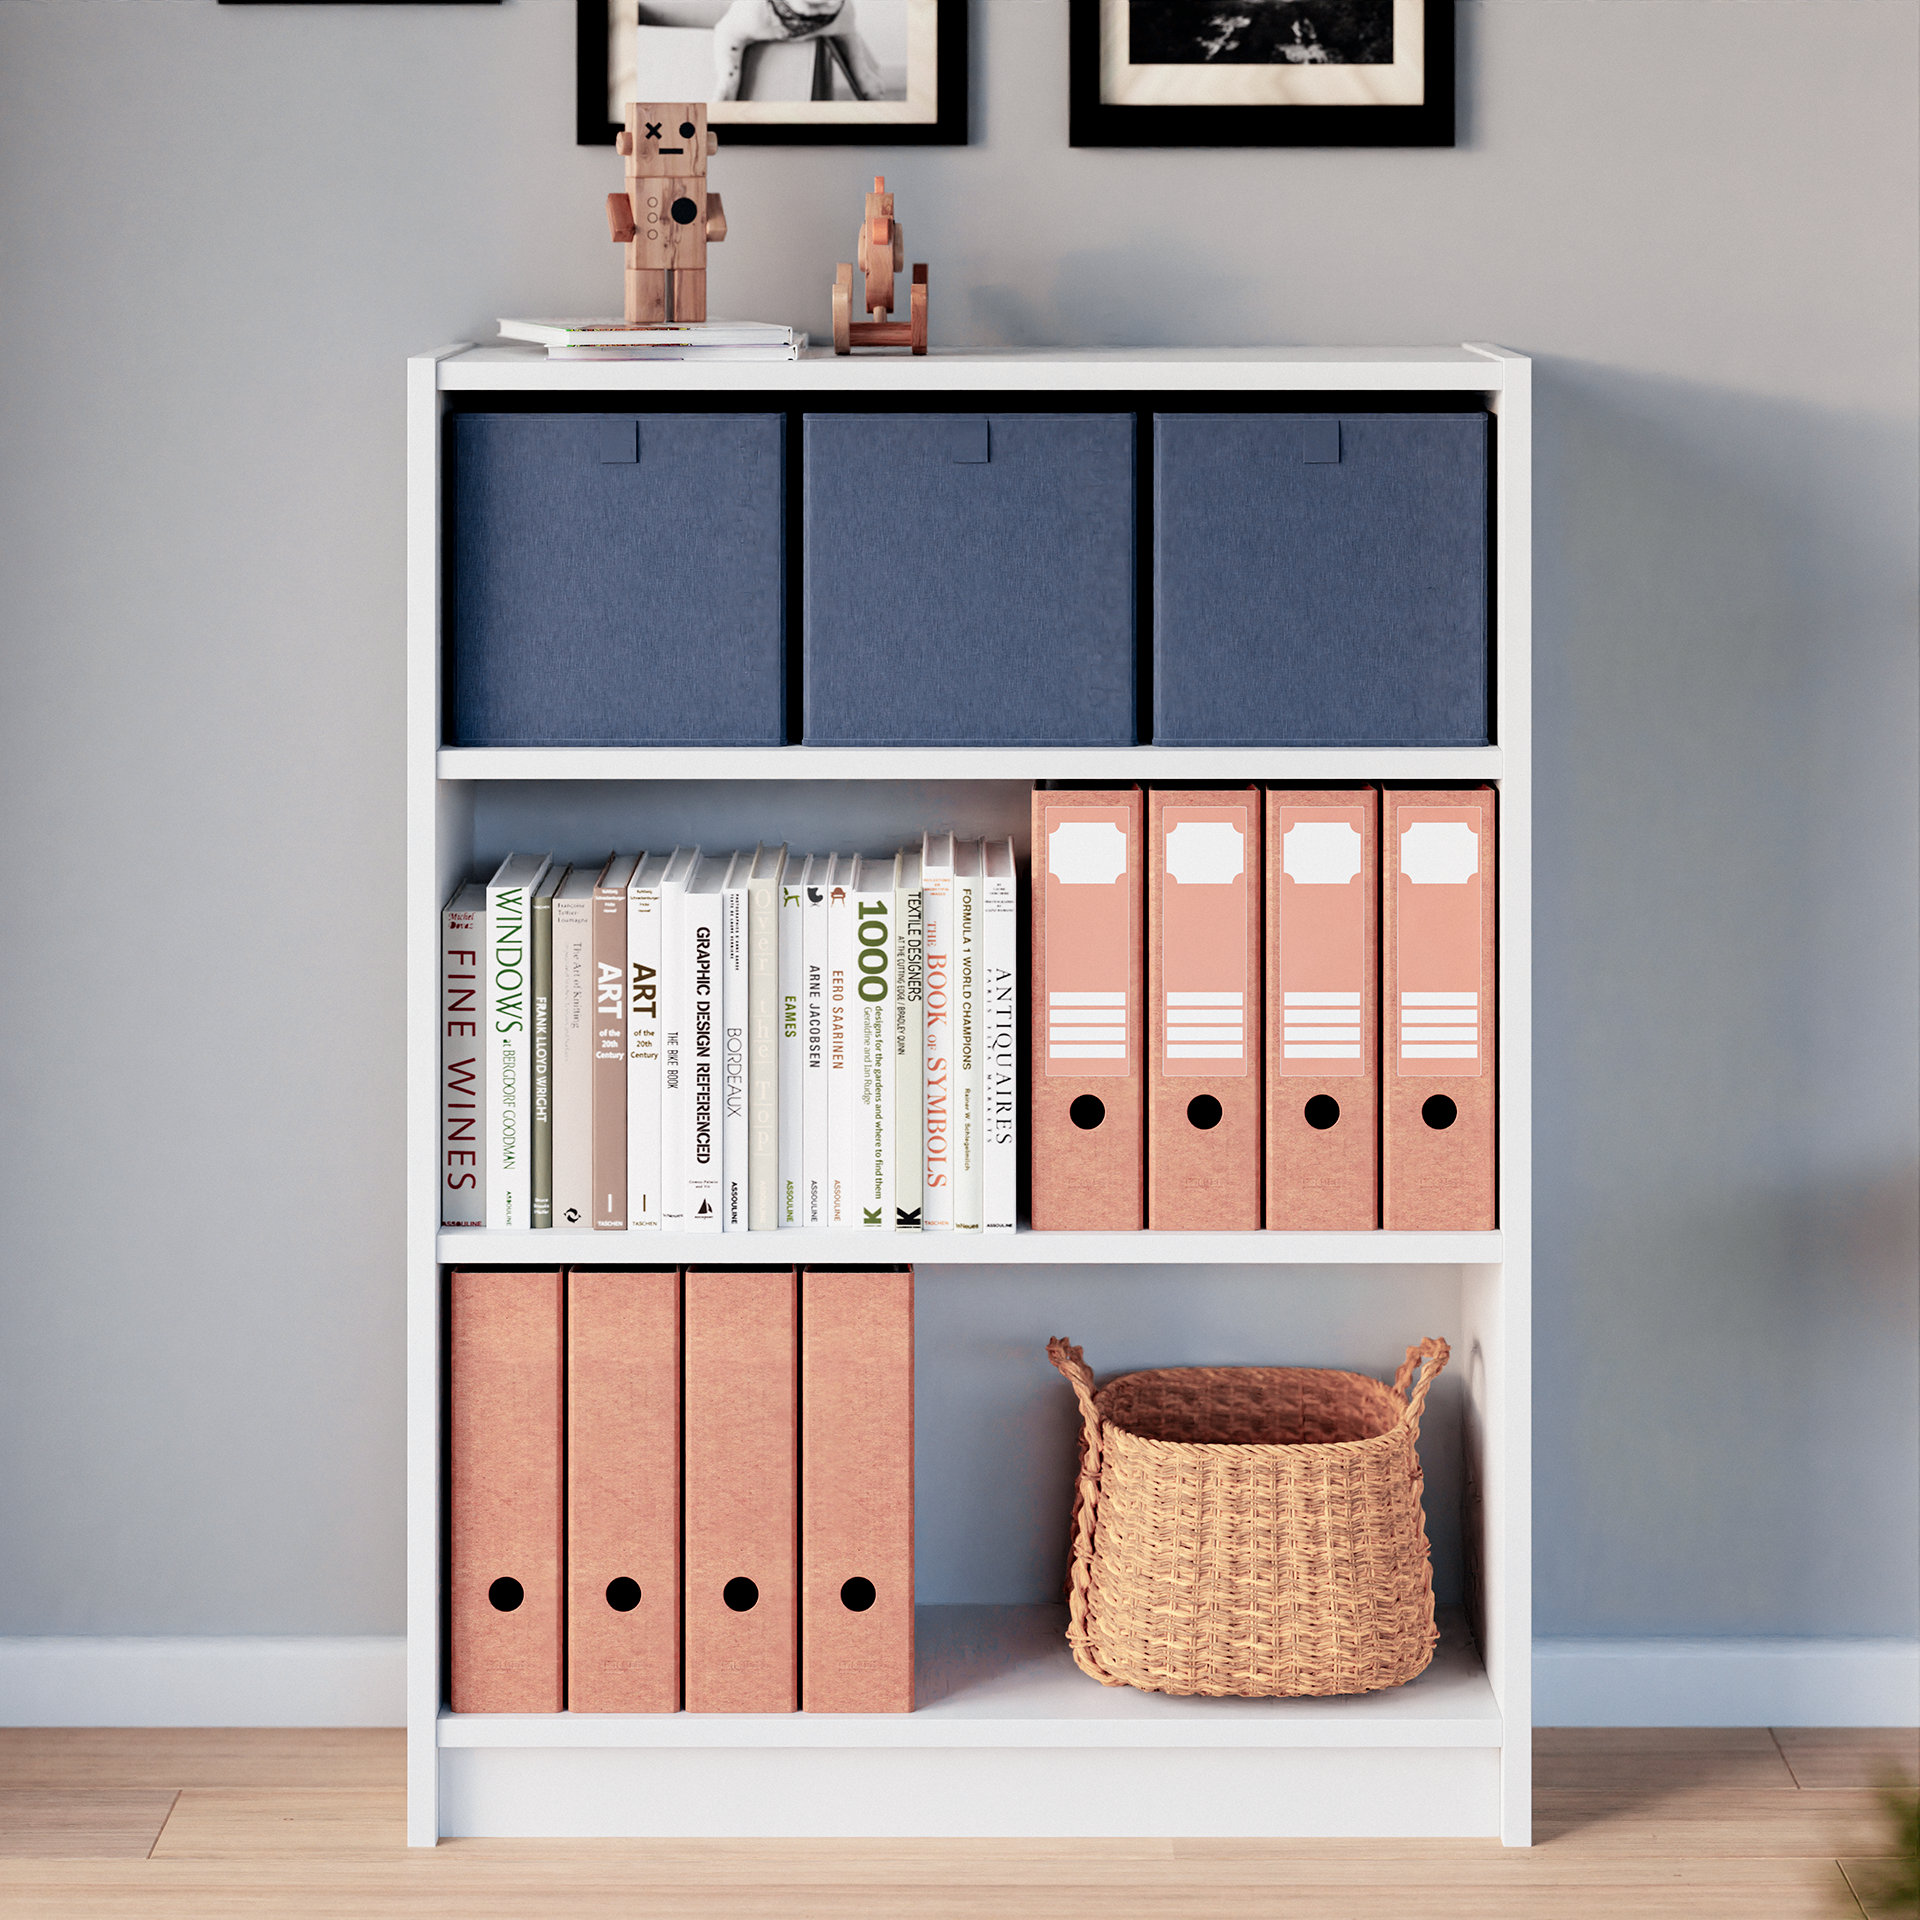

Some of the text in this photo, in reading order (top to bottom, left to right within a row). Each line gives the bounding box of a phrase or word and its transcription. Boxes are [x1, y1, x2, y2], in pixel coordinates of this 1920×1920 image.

[927, 921, 937, 947] THE
[962, 889, 972, 944] FORMULA
[573, 942, 582, 960] The
[573, 962, 582, 977] Art
[696, 927, 710, 996] GRAPHIC
[858, 900, 888, 1002] 1000
[897, 945, 905, 957] THE
[897, 958, 905, 985] CUTTING
[908, 892, 922, 1002] TEXTILE DESIGNERS
[598, 961, 623, 1019] ART
[633, 962, 656, 1018] ART
[897, 986, 905, 1001] EDGE
[927, 953, 947, 1028] BOOK
[962, 957, 972, 999] WORLD
[495, 888, 523, 1169] WINDOWS at BERGDORF GOODMAN
[599, 1029, 621, 1037] of the
[602, 1040, 618, 1048] 20th
[633, 1029, 655, 1037] of the
[636, 1040, 652, 1048] 20th
[696, 1001, 710, 1057] DESIGN
[784, 996, 797, 1038] EAMES
[809, 965, 821, 1068] ARNE JACOBSEN
[832, 970, 844, 1070] EERO SAARINEN
[897, 1007, 906, 1034] BRADLEY
[962, 1002, 972, 1071] CHAMPIONS
[447, 950, 476, 1190] FINE WINES
[536, 997, 547, 1123] FRANK LLOYD WRIGHT
[595, 1051, 625, 1061] Century
[630, 1051, 659, 1060] Century
[667, 1032, 679, 1089] THE BIKE BOOK
[726, 1027, 743, 1118] BORDEAUX
[862, 1007, 872, 1105] Geraldine and Ian Rudge
[897, 1035, 905, 1055] QUINN
[992, 969, 1012, 1144] ANTIQUAIRES
[696, 1063, 710, 1164] REFERENCED
[873, 1006, 883, 1199] designs for the gardens and where to find them
[927, 1057, 948, 1188] SYMBOLS
[786, 1180, 794, 1223] ASSOULINE
[810, 1180, 818, 1222] ASSOULINE
